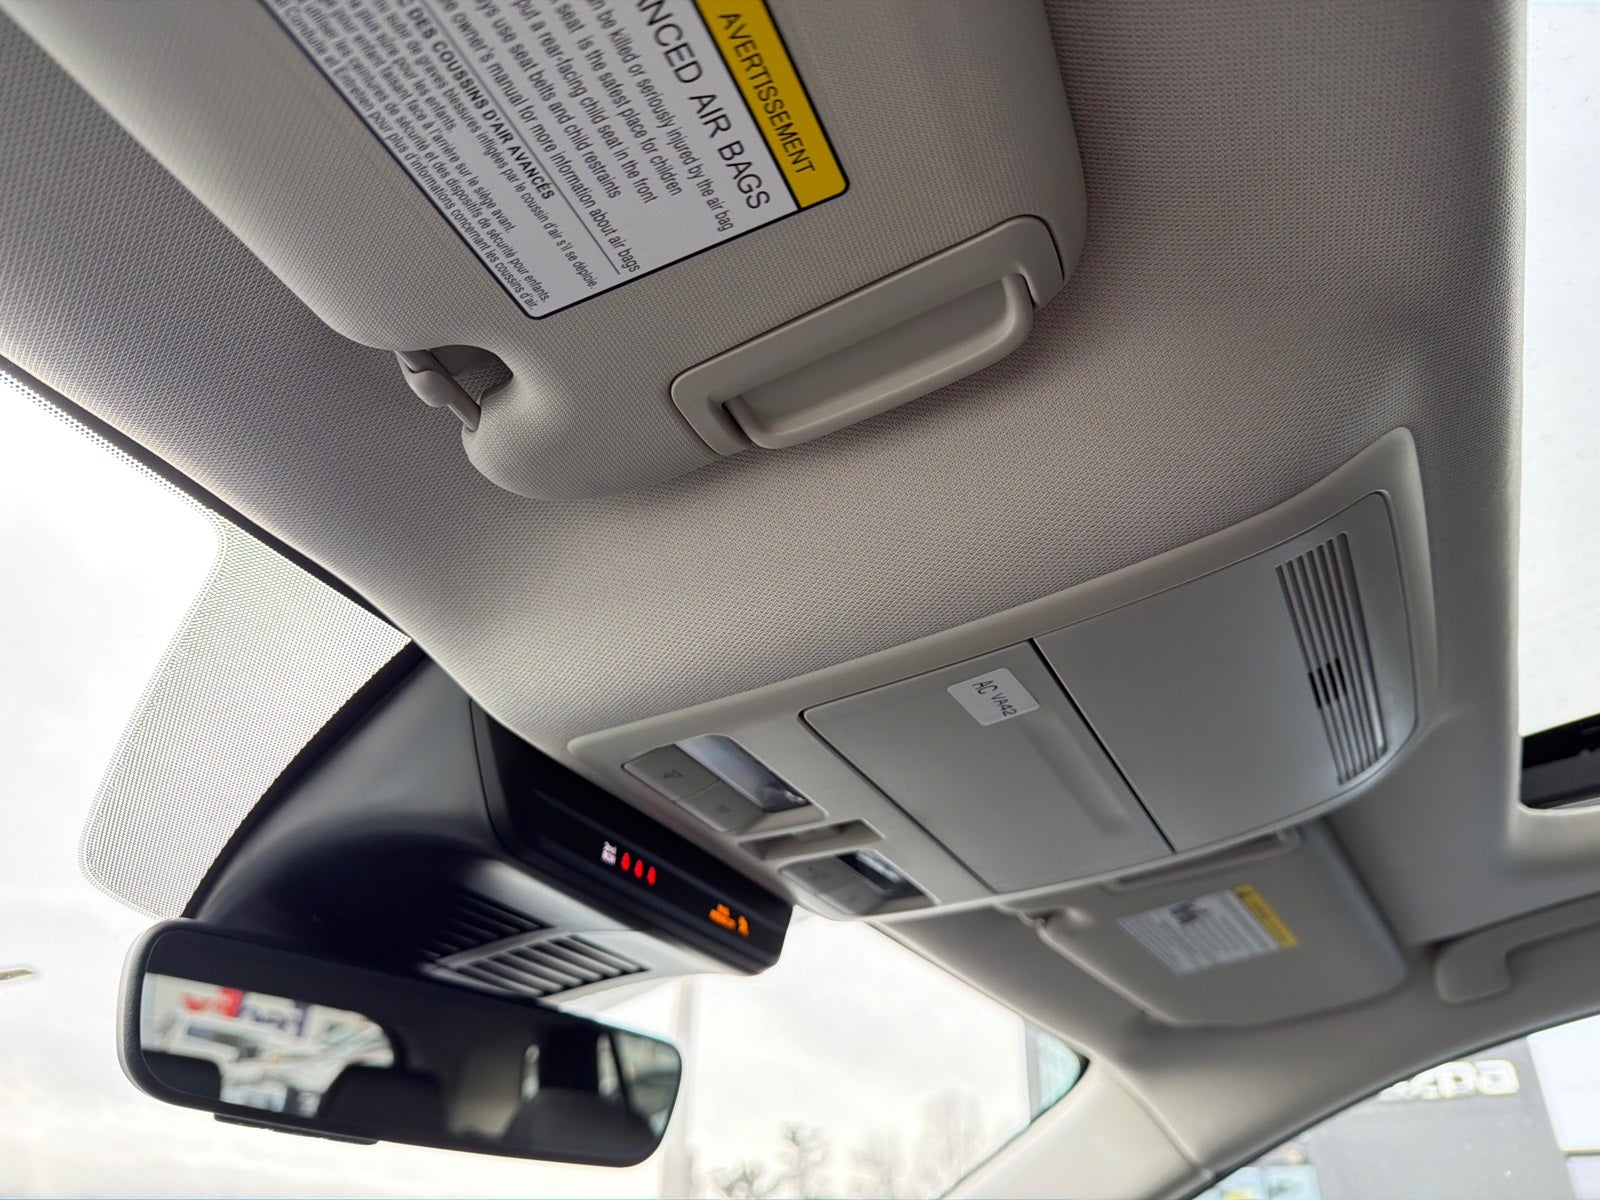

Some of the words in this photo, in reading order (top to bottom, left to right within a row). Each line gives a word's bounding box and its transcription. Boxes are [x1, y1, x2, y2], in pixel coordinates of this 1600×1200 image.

[529, 20, 546, 33] a
[554, 3, 587, 34] seat
[595, 8, 617, 30] be
[576, 34, 595, 51] is
[607, 27, 642, 64] killed
[537, 31, 588, 99] rear-facing
[584, 48, 607, 72] the
[627, 63, 647, 78] or
[406, 7, 438, 40] DES
[431, 40, 490, 110] COUSSINS
[481, 109, 514, 145] D'AIR
[506, 145, 556, 200] AVANCÉS
[597, 71, 632, 109] safest
[635, 78, 676, 129] seriously
[718, 12, 816, 174] AVERTISSEMENT
[491, 17, 518, 44] use
[508, 43, 540, 73] seat
[527, 69, 557, 102] belts
[547, 101, 576, 125] and
[563, 124, 594, 152] child
[581, 150, 622, 199] restraints
[579, 96, 610, 125] child
[596, 124, 625, 150] seat
[615, 107, 648, 139] place
[450, 12, 495, 64] owner's
[486, 62, 530, 108] manual
[517, 104, 539, 124] for
[529, 123, 558, 153] more
[549, 150, 597, 209] information
[588, 208, 619, 237] about
[607, 235, 627, 249] air
[617, 247, 641, 273] bags
[612, 146, 630, 162] in
[639, 137, 659, 155] for
[666, 126, 701, 166] injured
[688, 94, 732, 139] AIR
[717, 140, 771, 210] BAGS
[620, 159, 641, 179] the
[649, 155, 683, 197] children
[686, 163, 706, 180] by
[632, 177, 659, 204] front
[695, 178, 715, 197] the
[705, 197, 725, 211] air
[714, 209, 735, 233] bag
[971, 680, 998, 695] AC
[991, 692, 1017, 717] VA42
